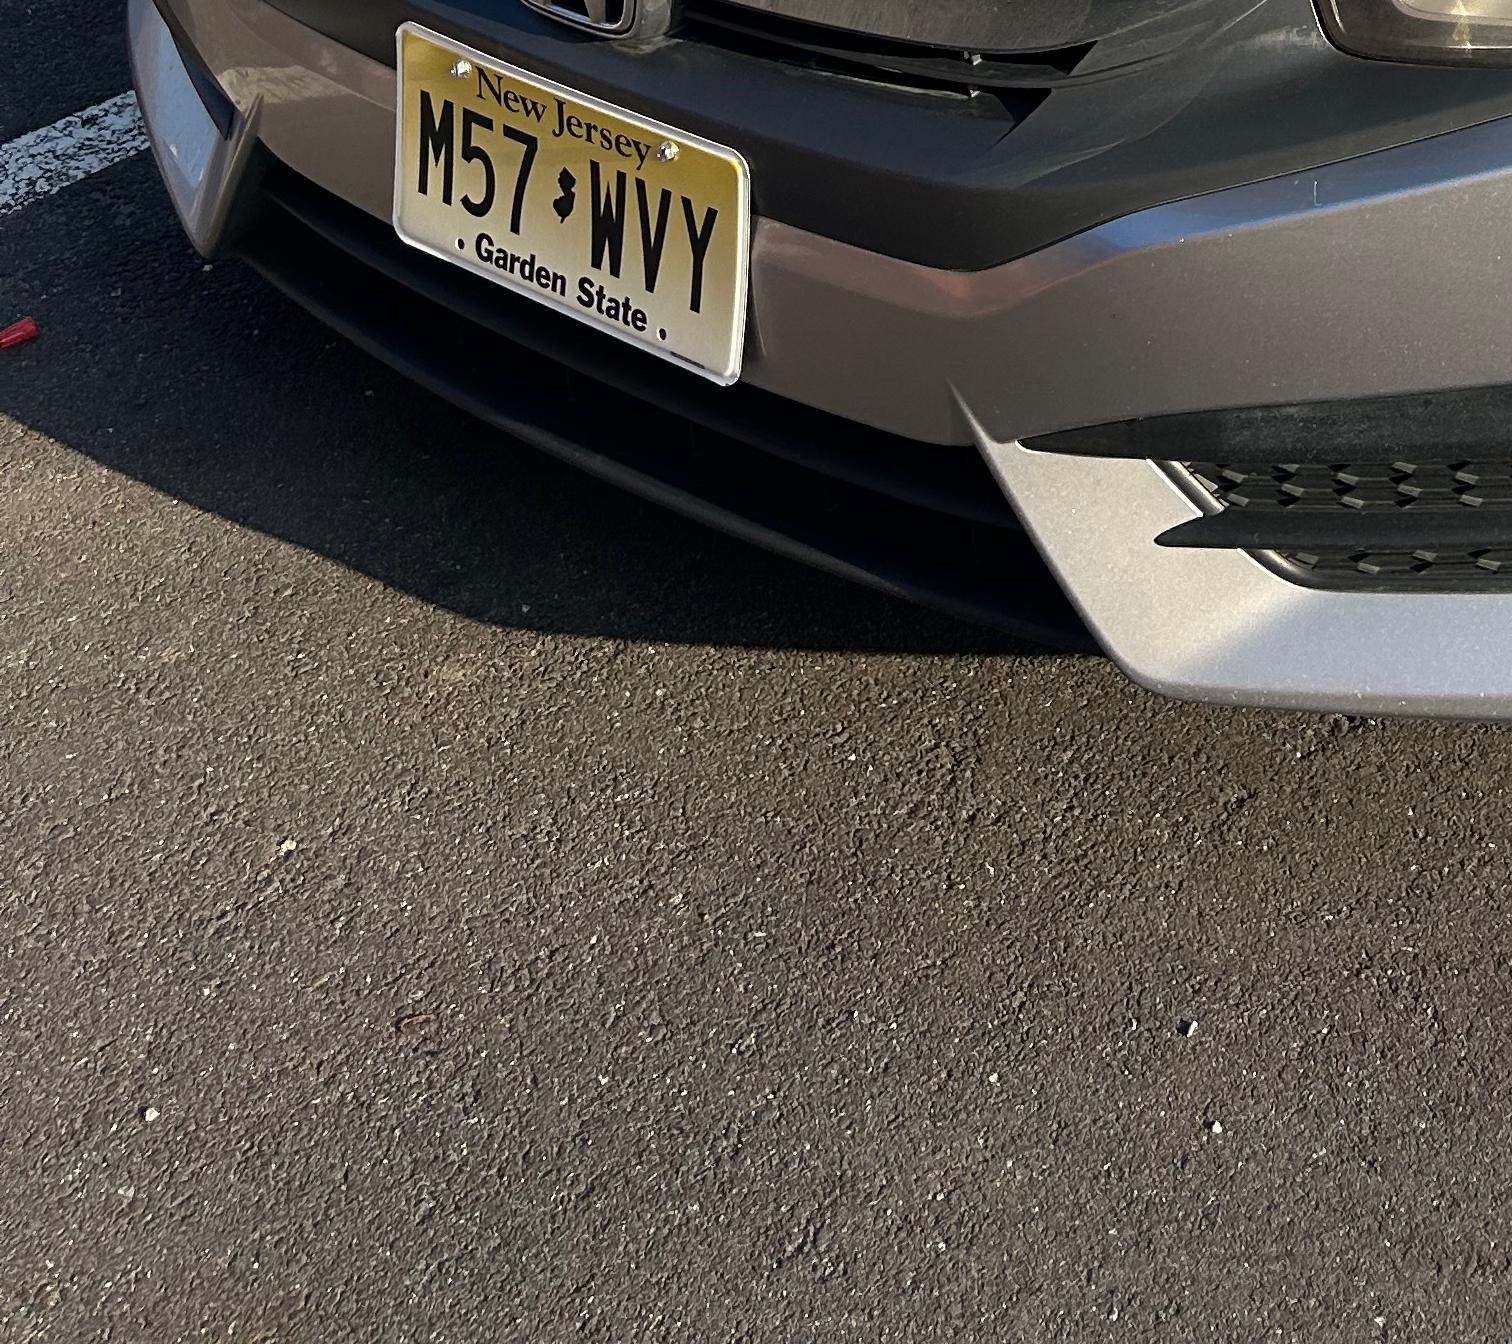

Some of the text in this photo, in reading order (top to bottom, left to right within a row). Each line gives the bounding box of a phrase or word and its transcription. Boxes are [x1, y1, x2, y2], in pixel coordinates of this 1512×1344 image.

[475, 66, 652, 170] New Jersey
[417, 89, 719, 314] M57 WVY
[475, 232, 648, 332] Garden State
